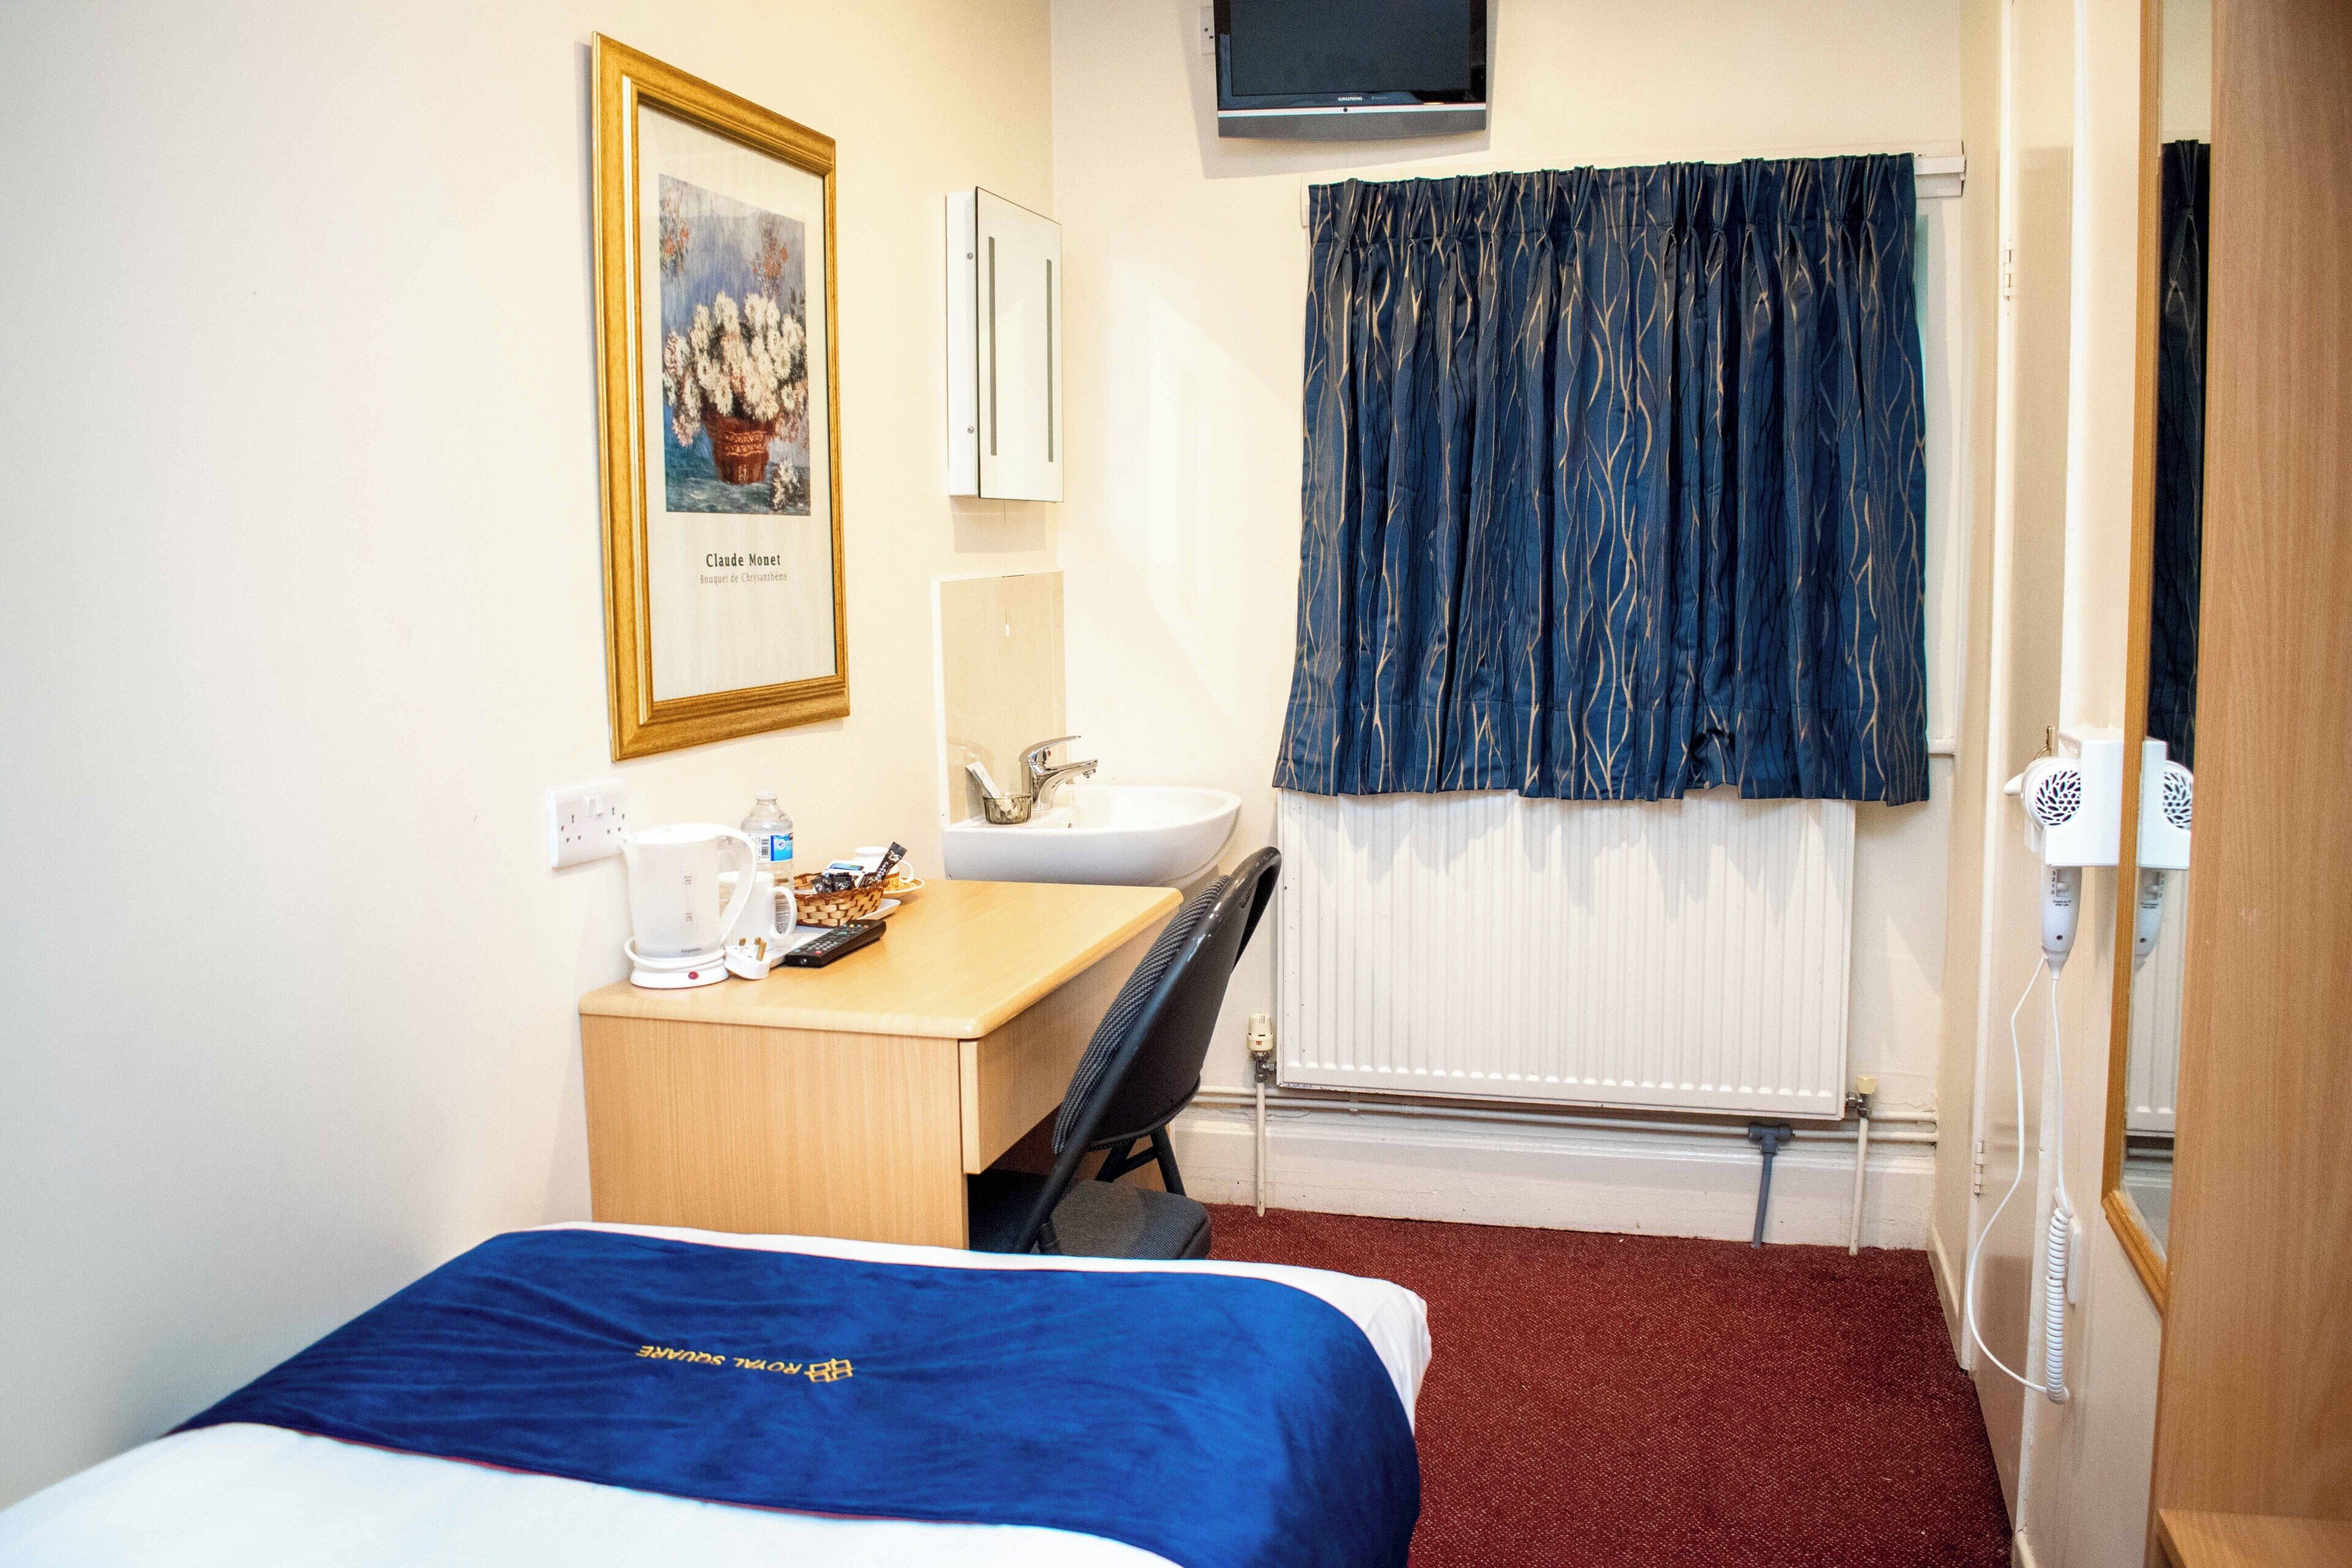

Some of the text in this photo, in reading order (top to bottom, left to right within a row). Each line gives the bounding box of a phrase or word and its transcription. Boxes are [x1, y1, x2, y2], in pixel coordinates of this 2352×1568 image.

[706, 553, 781, 567] Claude Monet
[700, 574, 728, 585] Bouquet
[730, 573, 738, 582] de
[635, 1345, 802, 1374] ROYAL SQUARE
